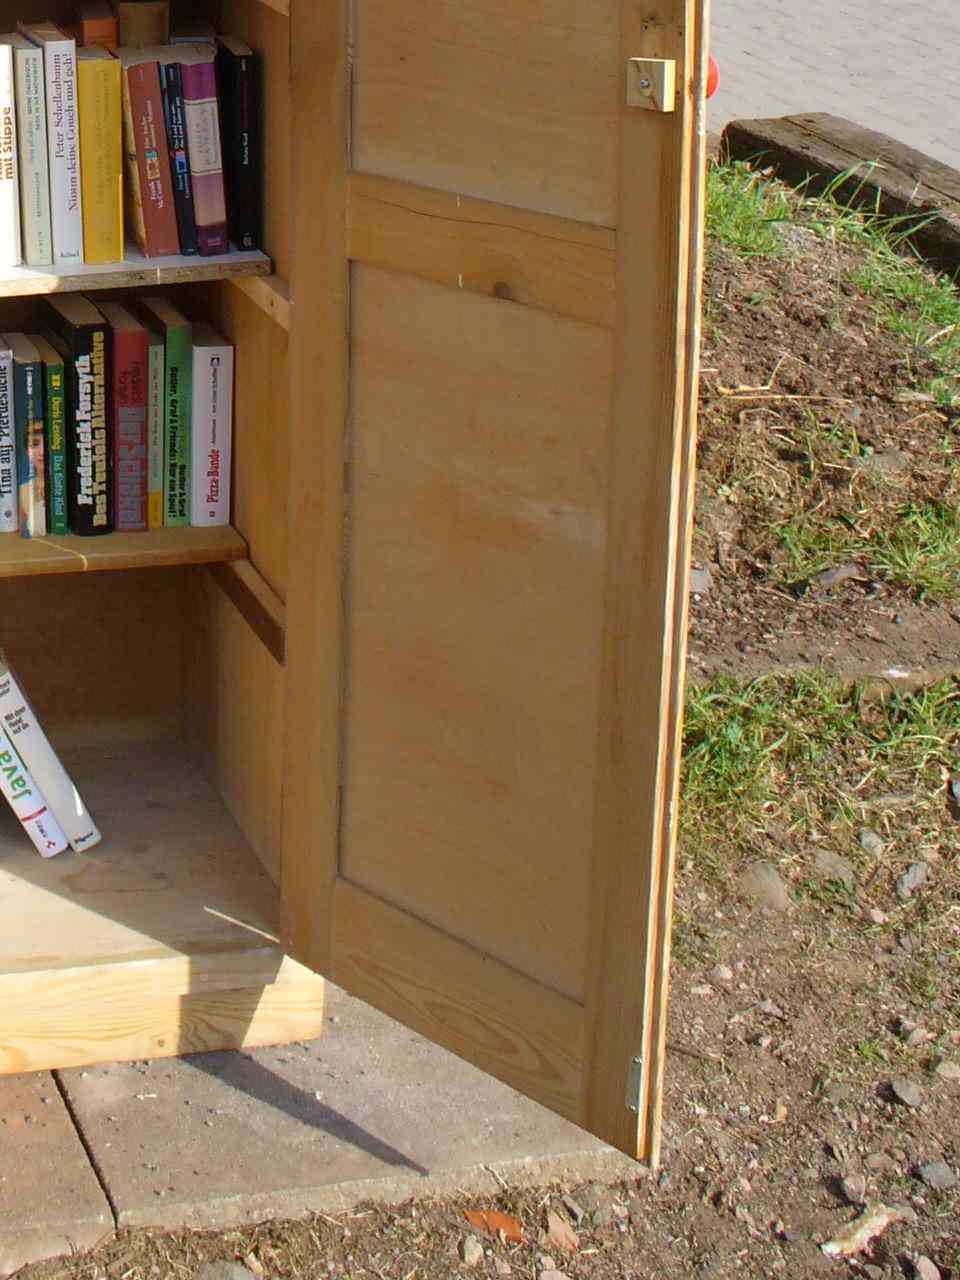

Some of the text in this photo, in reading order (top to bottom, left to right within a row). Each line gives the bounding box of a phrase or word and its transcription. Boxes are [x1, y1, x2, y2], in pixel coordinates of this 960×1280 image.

[52, 54, 65, 159] Peter Schellenbaum
[64, 81, 74, 101] und
[1, 106, 14, 181] mit Stippe
[64, 105, 76, 140] Couch
[66, 146, 77, 174] deine
[67, 176, 79, 211] Nimm
[75, 354, 94, 505] Frederick Forsyth
[91, 330, 107, 527] Des Teufels Alternative
[206, 447, 222, 503] Pizza-Bande
